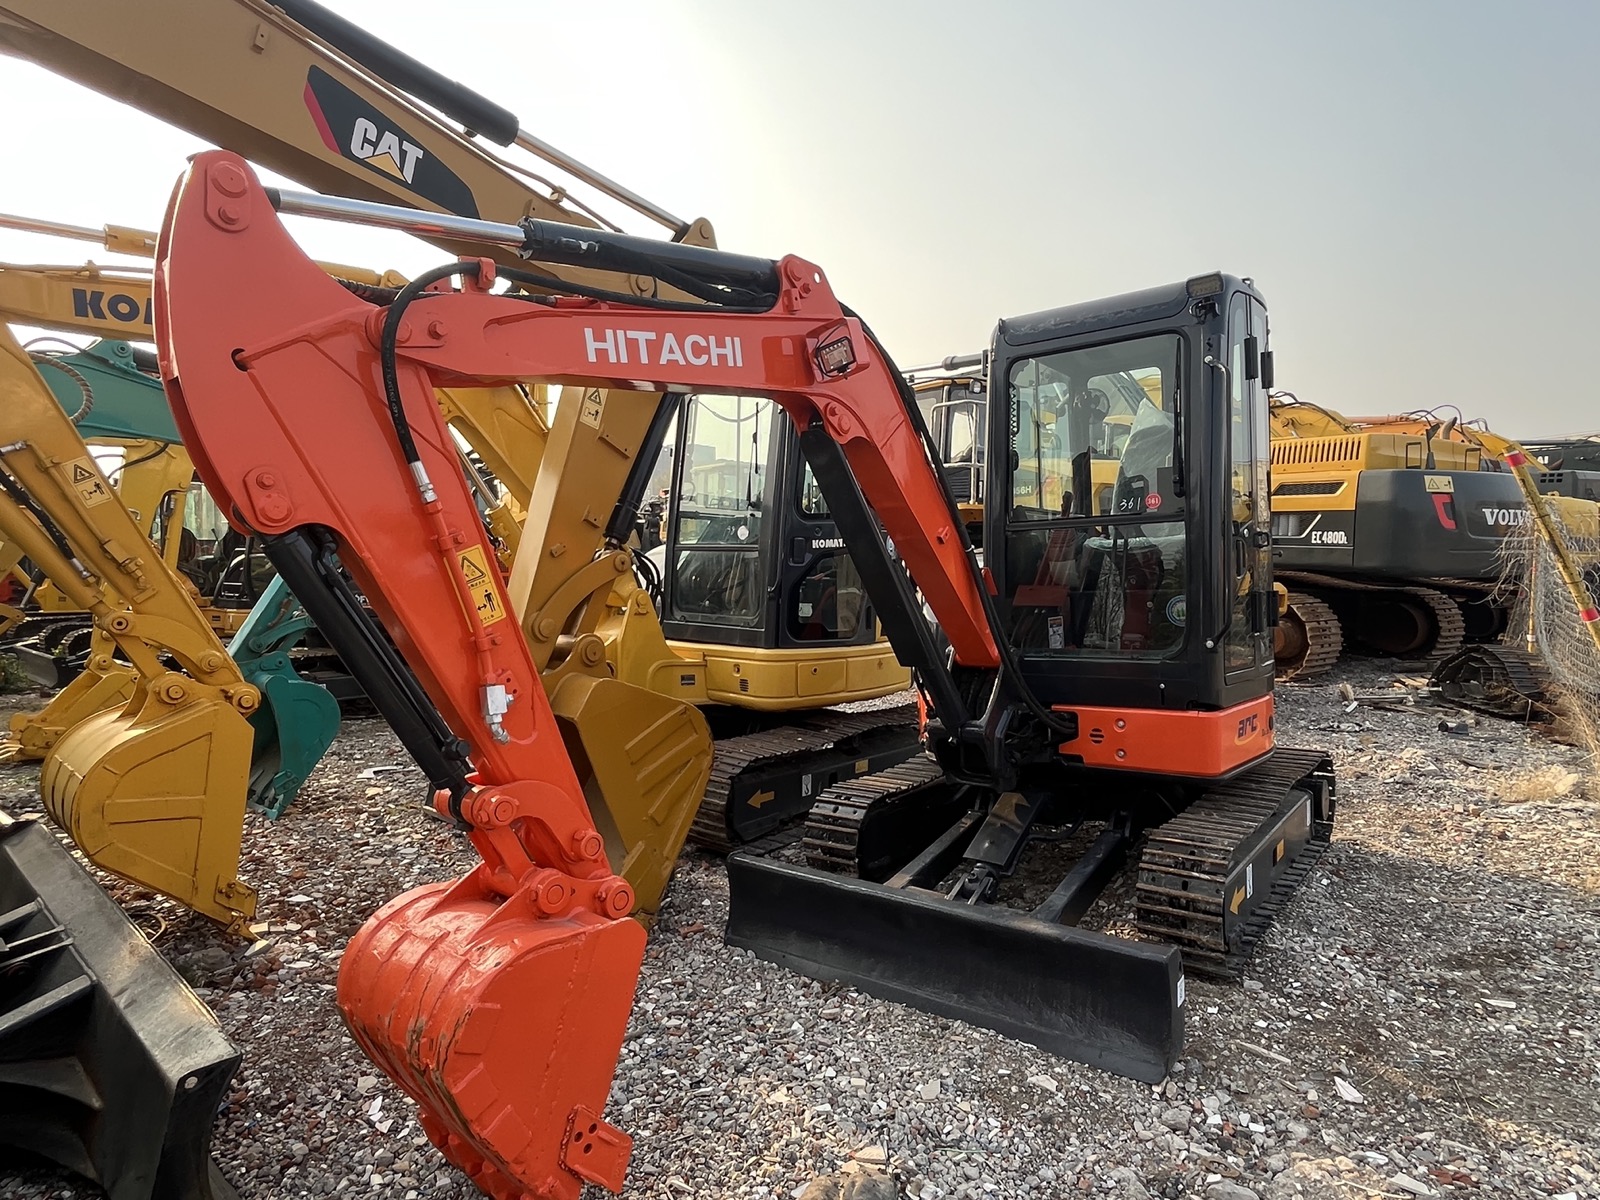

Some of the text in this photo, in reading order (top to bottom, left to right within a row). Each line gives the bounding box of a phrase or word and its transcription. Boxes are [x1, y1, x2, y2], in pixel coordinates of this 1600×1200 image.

[350, 117, 424, 184] CAT
[584, 327, 743, 367] HITACHI
[1120, 497, 1141, 511] 361
[1481, 508, 1531, 526] VOLV
